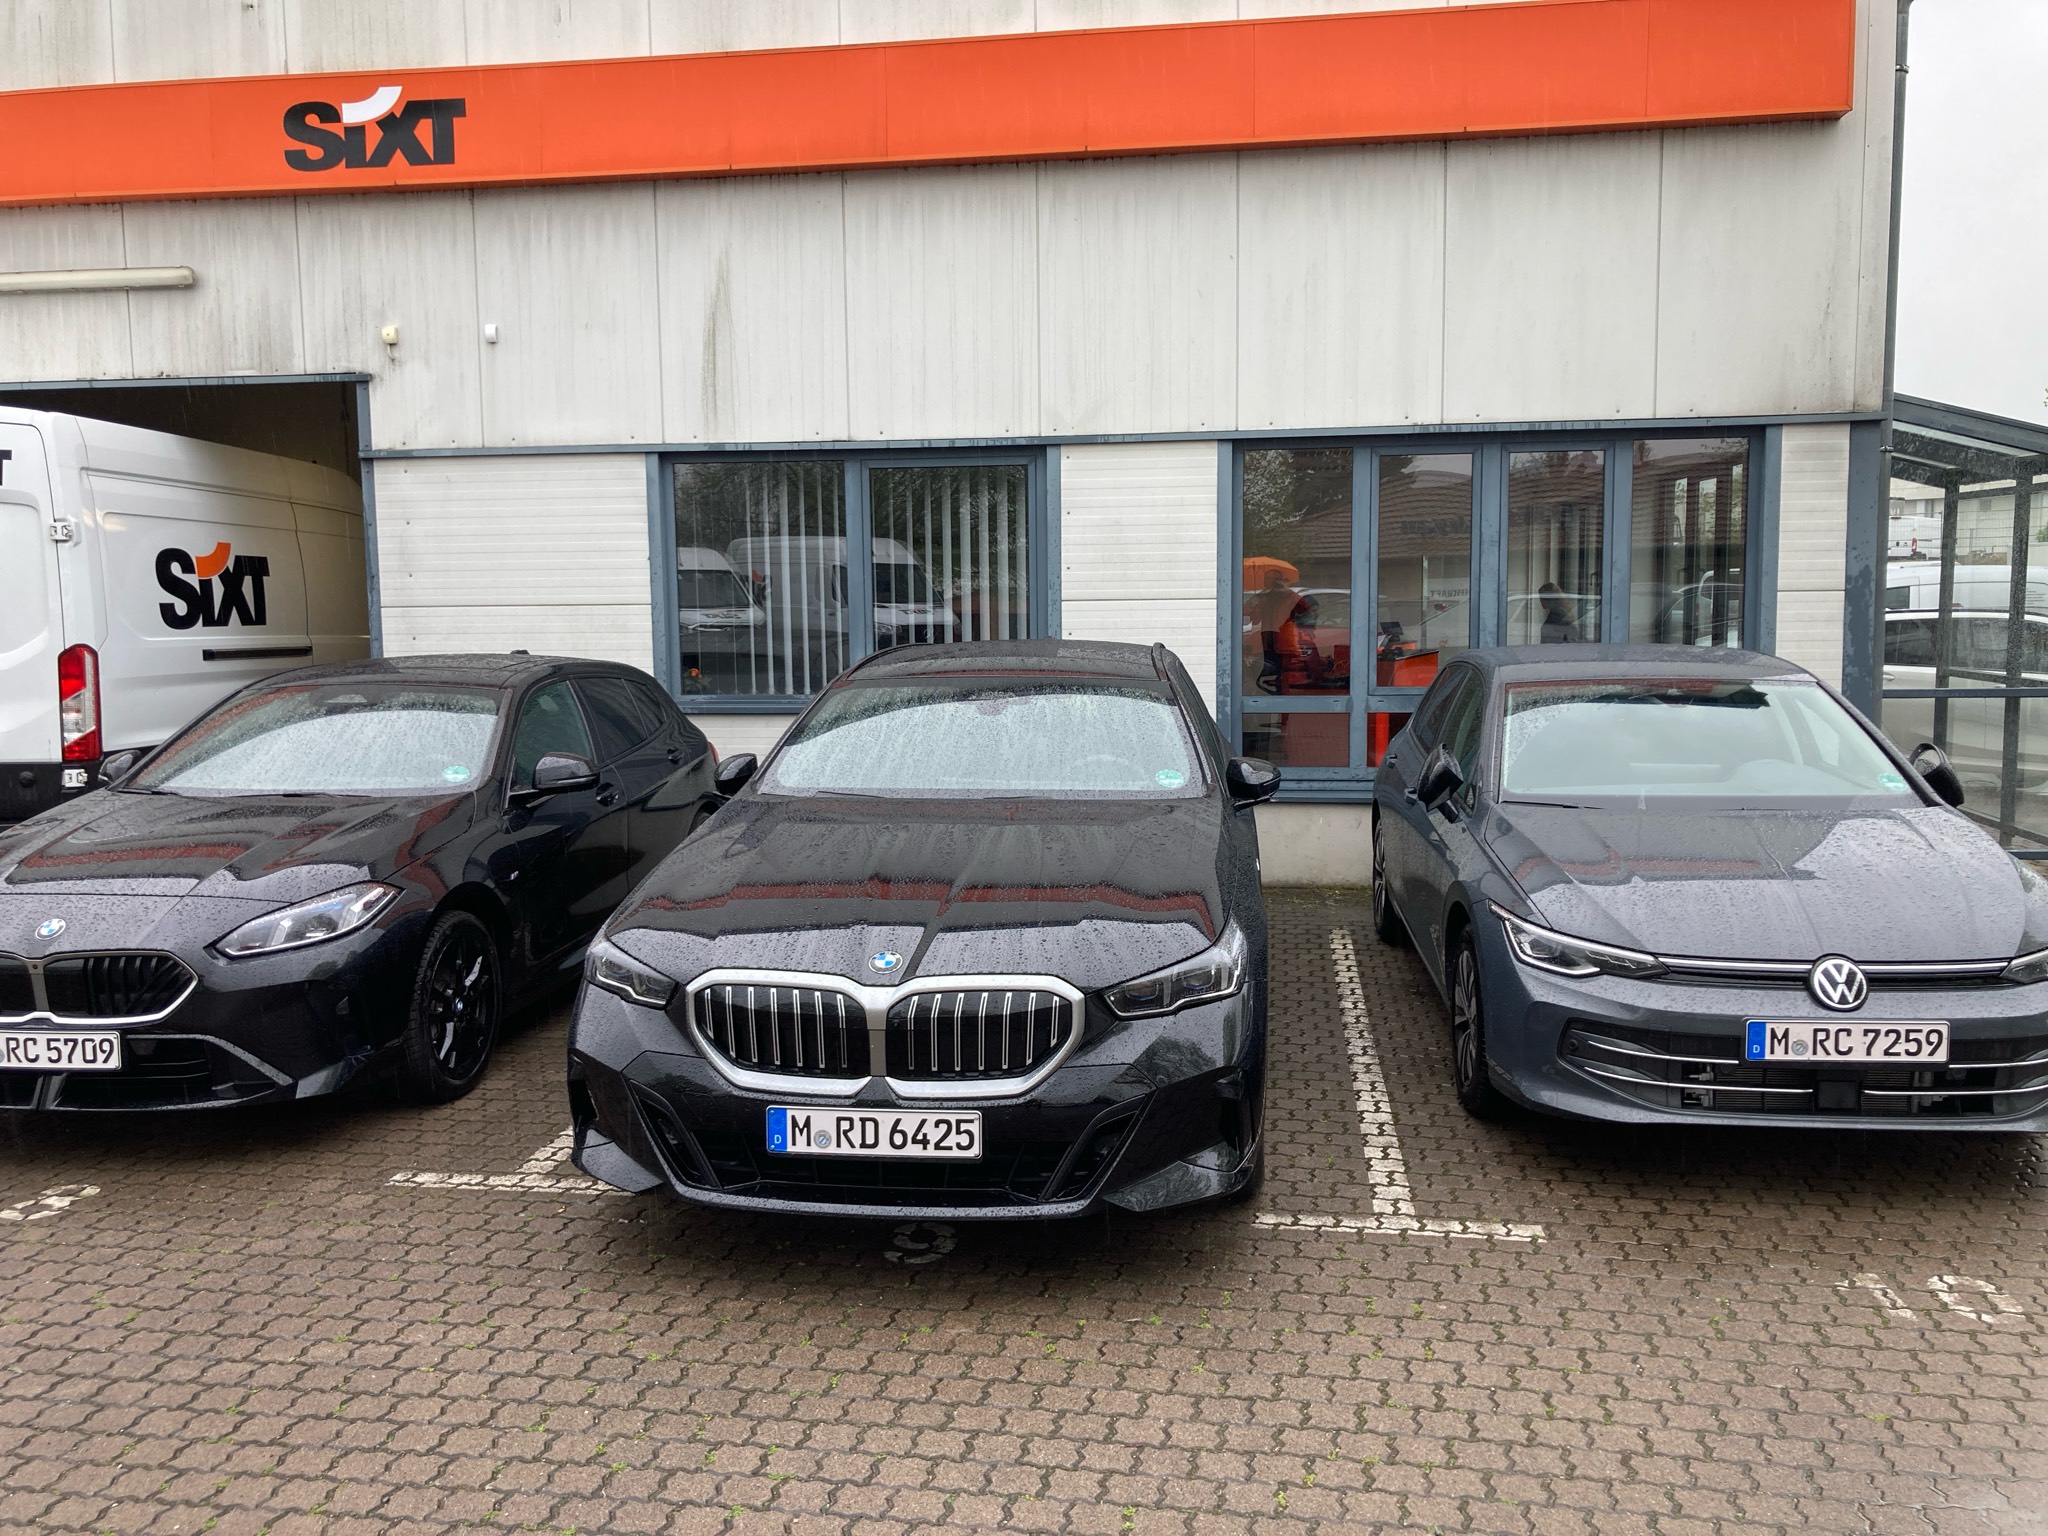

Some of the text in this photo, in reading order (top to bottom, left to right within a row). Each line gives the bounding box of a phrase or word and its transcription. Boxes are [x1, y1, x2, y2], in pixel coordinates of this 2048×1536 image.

[5, 1037, 115, 1064] RC 5709
[1753, 1027, 1944, 1057] D M RC 7259
[774, 1115, 975, 1151] D M RD 6425
